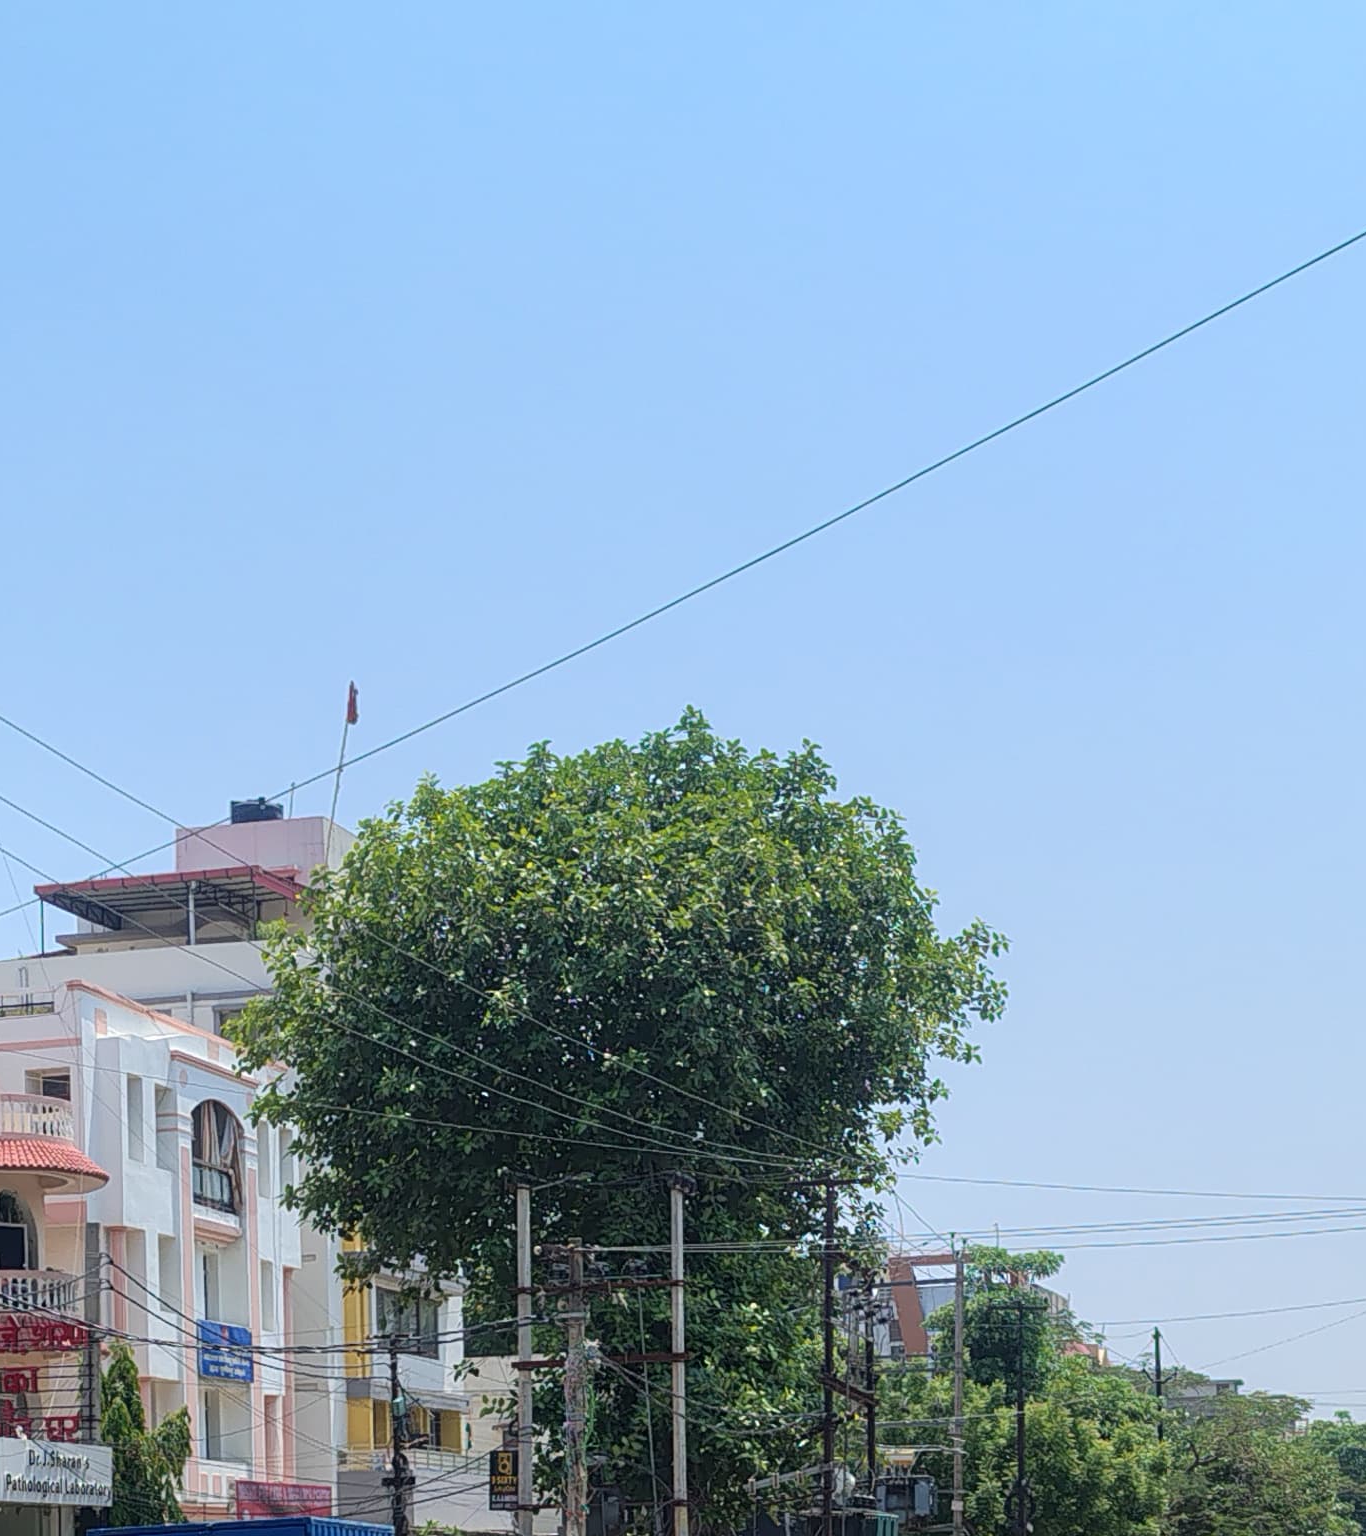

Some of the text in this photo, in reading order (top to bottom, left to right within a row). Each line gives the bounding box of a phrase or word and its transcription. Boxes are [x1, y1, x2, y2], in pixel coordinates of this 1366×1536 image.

[2, 1366, 40, 1394] का
[5, 1472, 112, 1502] Pathological Laboratory
